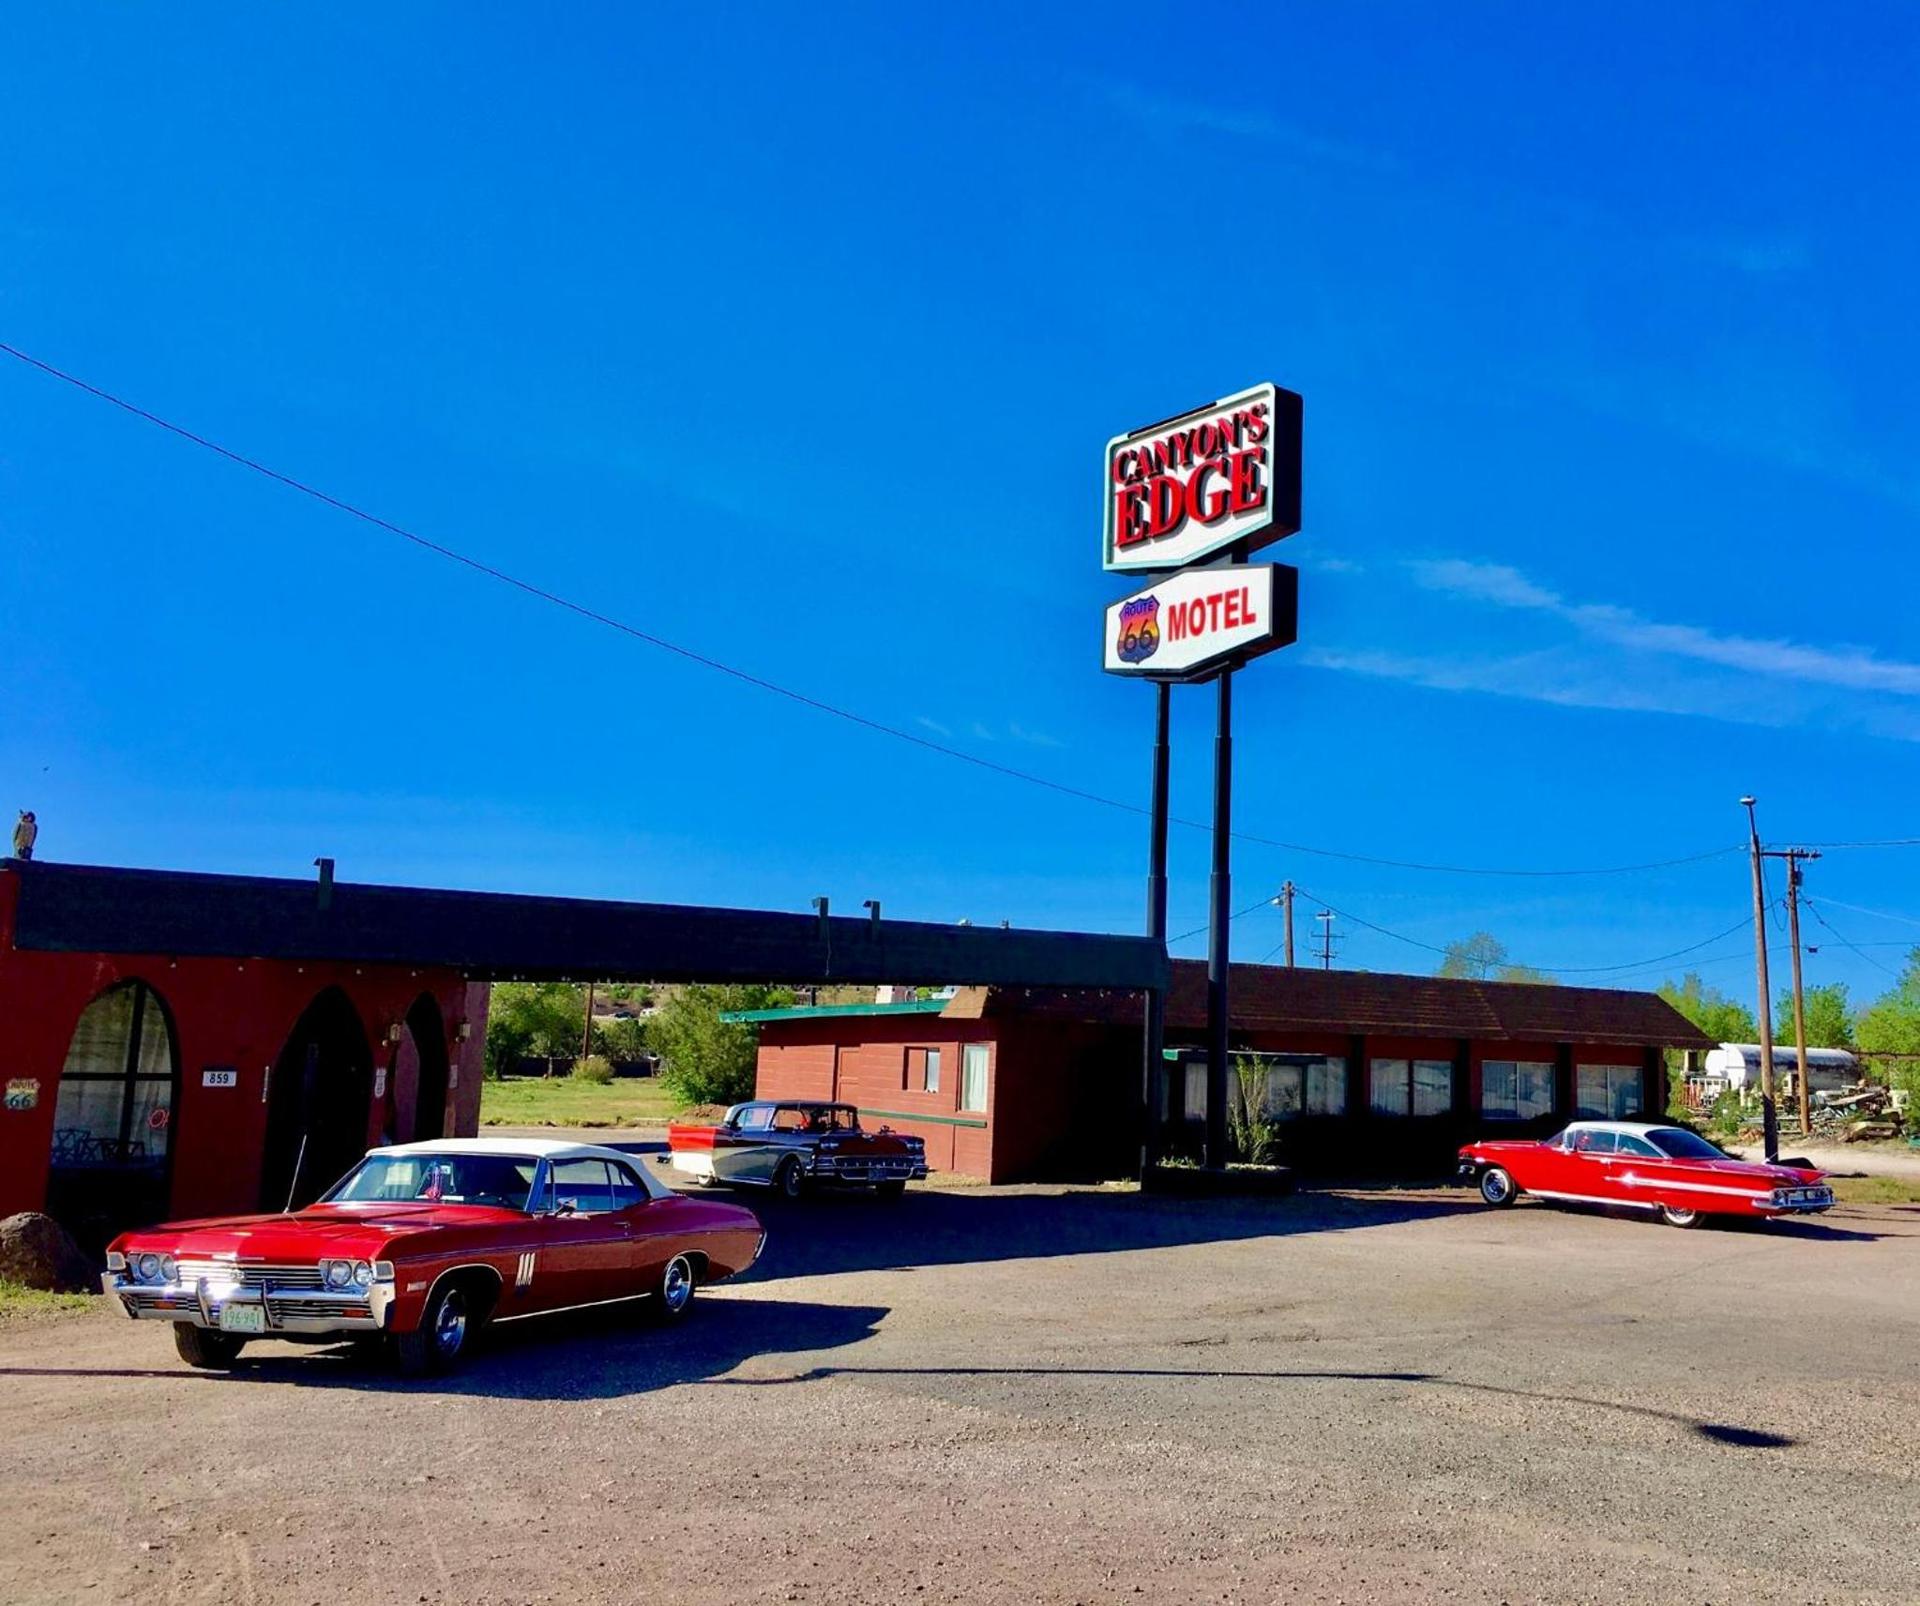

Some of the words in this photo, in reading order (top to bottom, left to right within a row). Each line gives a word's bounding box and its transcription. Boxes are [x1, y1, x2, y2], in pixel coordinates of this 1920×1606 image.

[1112, 403, 1269, 485] CANYON'S
[1113, 448, 1267, 548] EDGE
[1124, 600, 1153, 617] ROUTE
[1167, 586, 1257, 642] MOTEL
[1123, 618, 1154, 653] 66
[209, 1073, 229, 1084] 859
